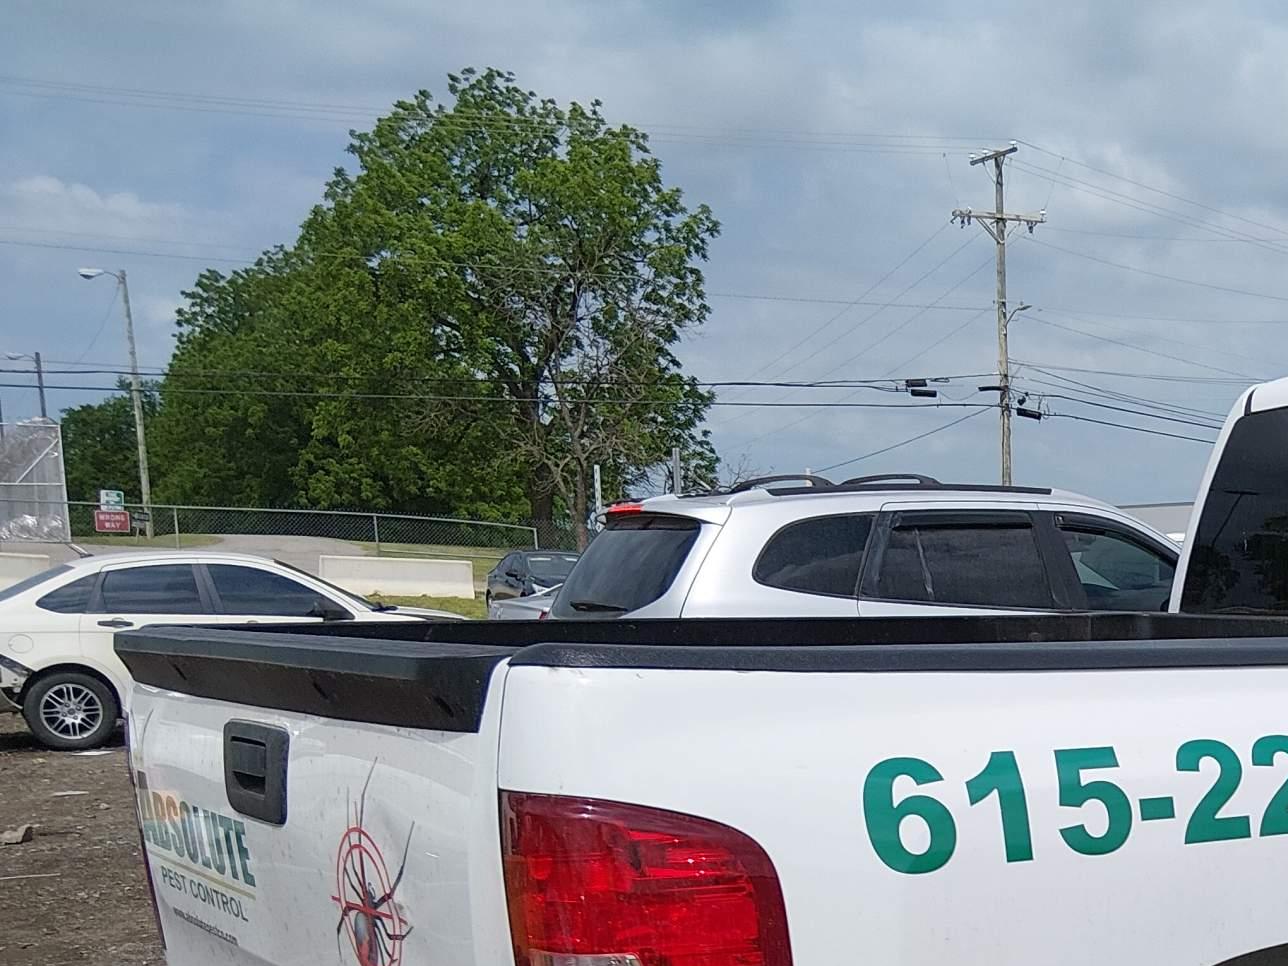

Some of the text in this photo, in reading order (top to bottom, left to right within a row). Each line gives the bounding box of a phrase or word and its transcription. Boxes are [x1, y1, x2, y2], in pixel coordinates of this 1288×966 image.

[98, 513, 126, 521] WRONG
[137, 769, 257, 887] ABSOLUTE
[161, 865, 249, 922] PEST CONTROL
